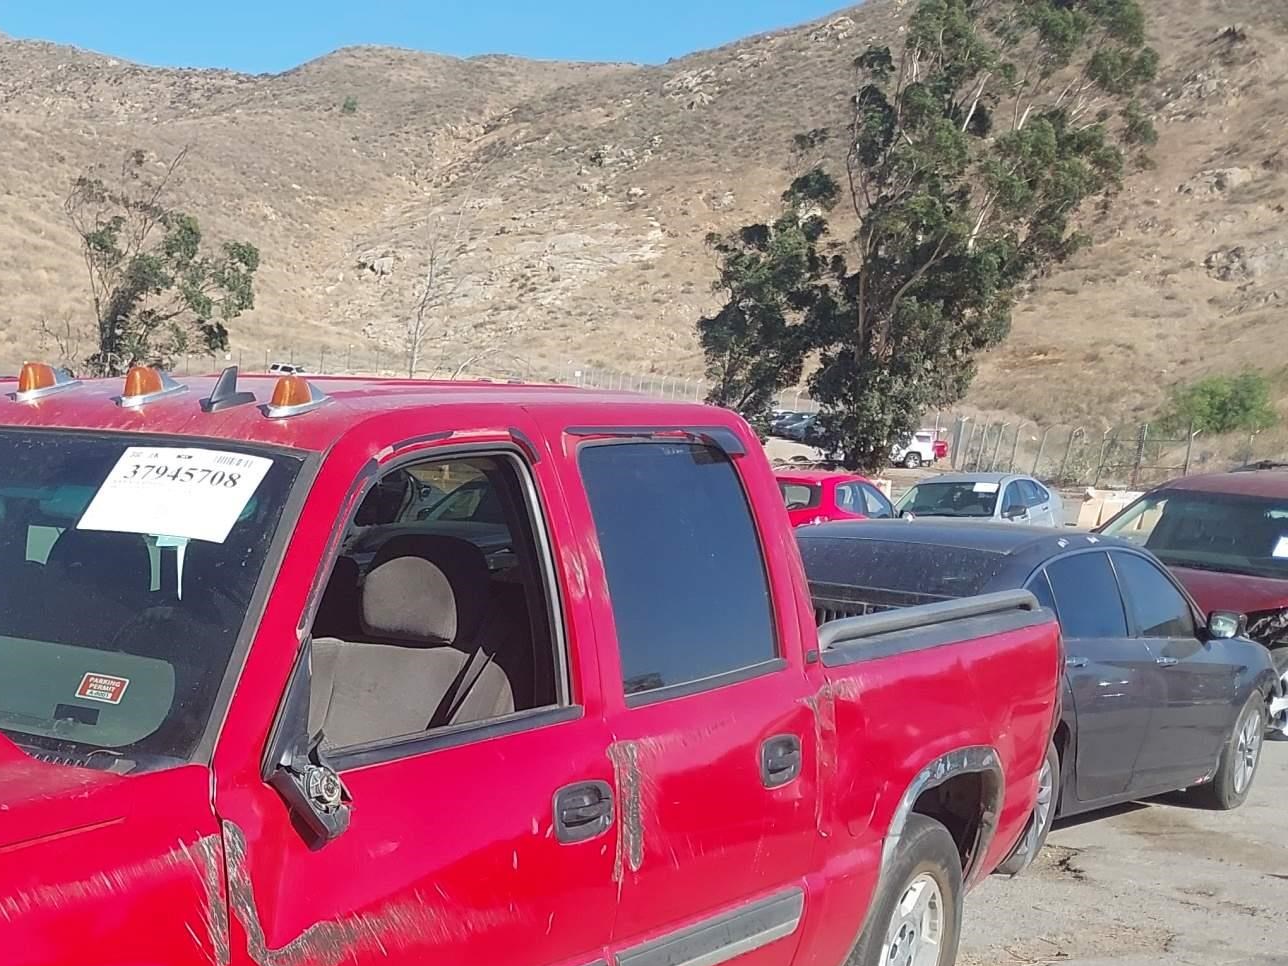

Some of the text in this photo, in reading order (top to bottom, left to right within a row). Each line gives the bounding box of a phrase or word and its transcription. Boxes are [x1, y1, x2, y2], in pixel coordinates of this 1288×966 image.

[123, 463, 242, 489] 37945708
[89, 677, 121, 687] PARKING
[89, 684, 116, 692] PERMIT
